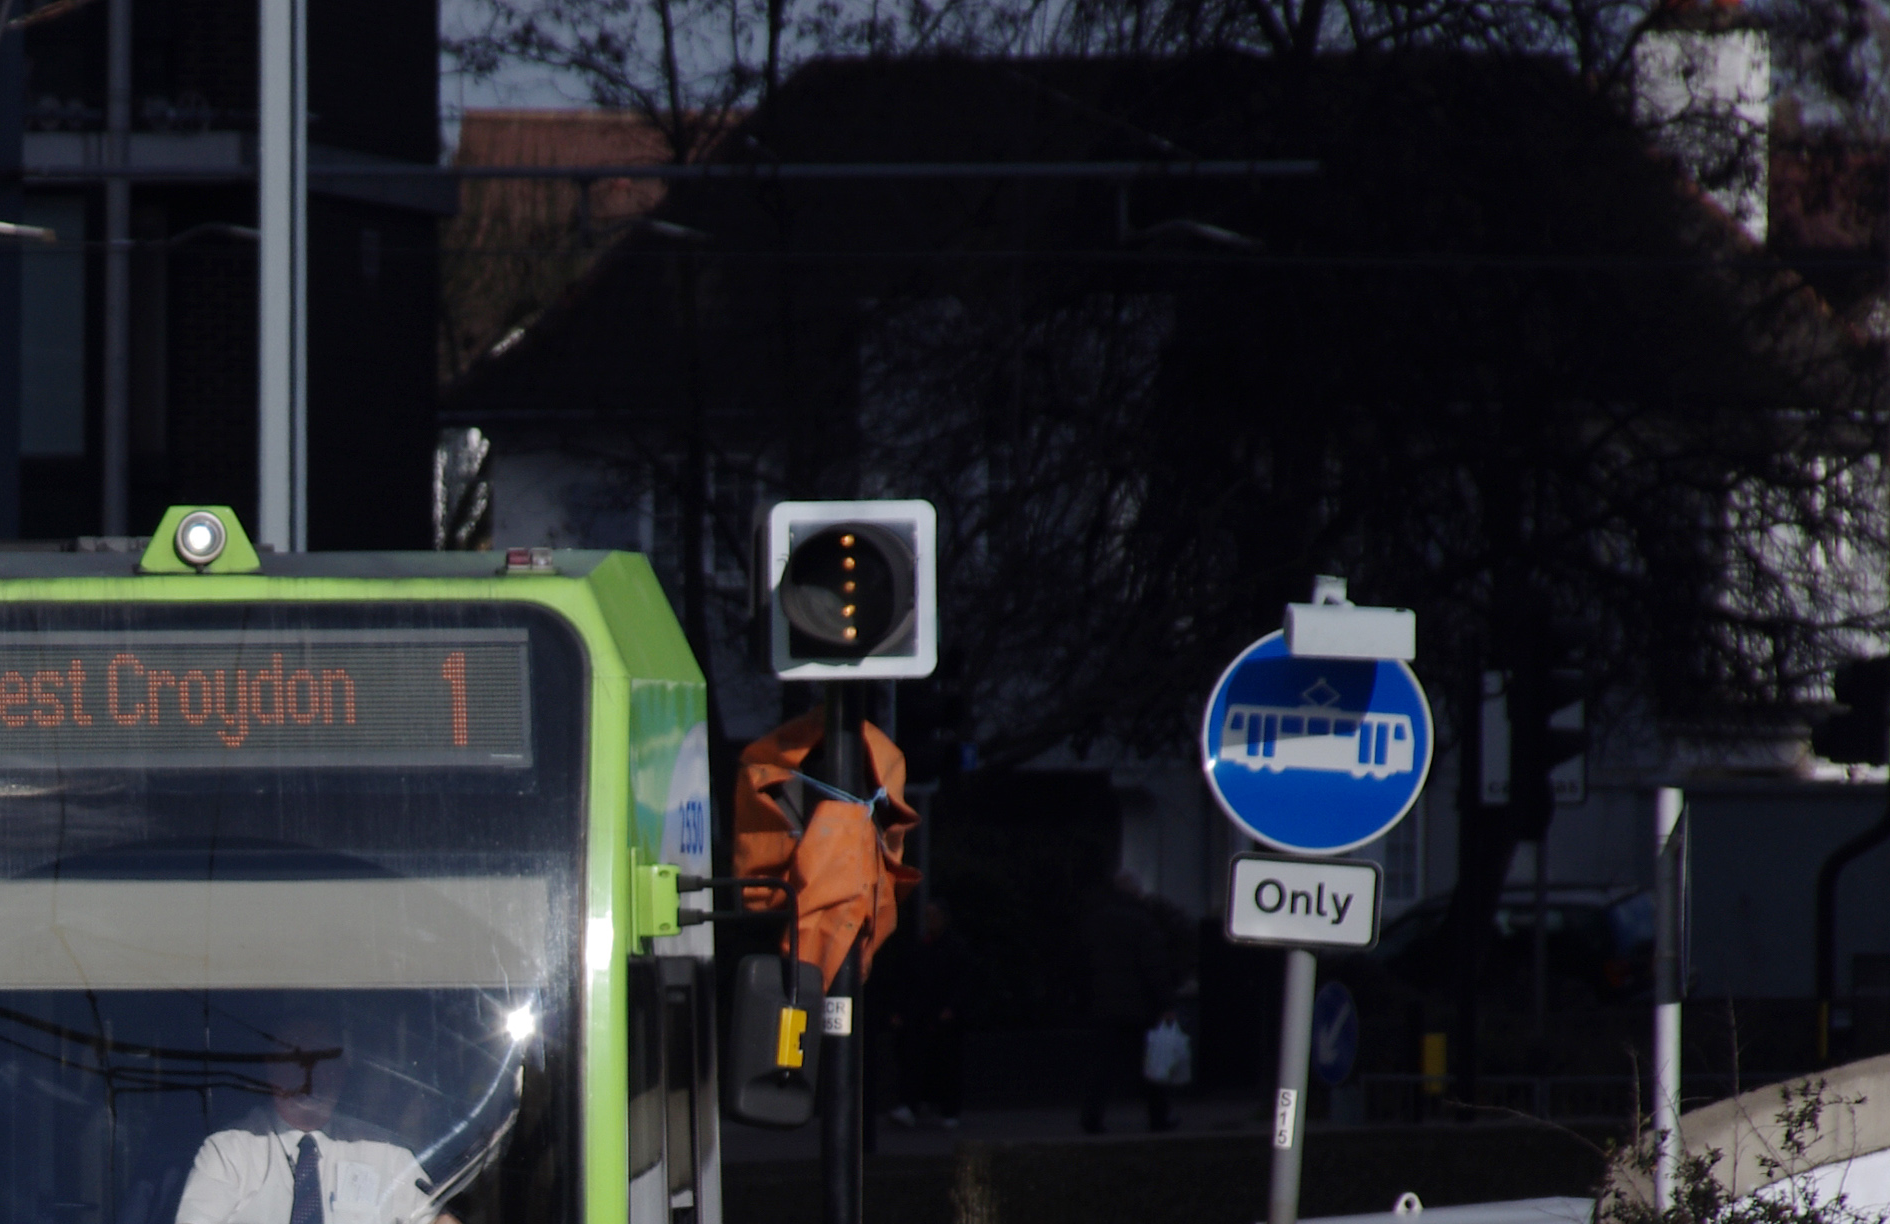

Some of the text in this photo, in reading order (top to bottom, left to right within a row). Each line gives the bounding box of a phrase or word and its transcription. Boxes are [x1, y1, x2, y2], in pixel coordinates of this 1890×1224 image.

[110, 653, 357, 748] Croydon
[442, 651, 468, 747] 1
[1254, 878, 1354, 925] Only
